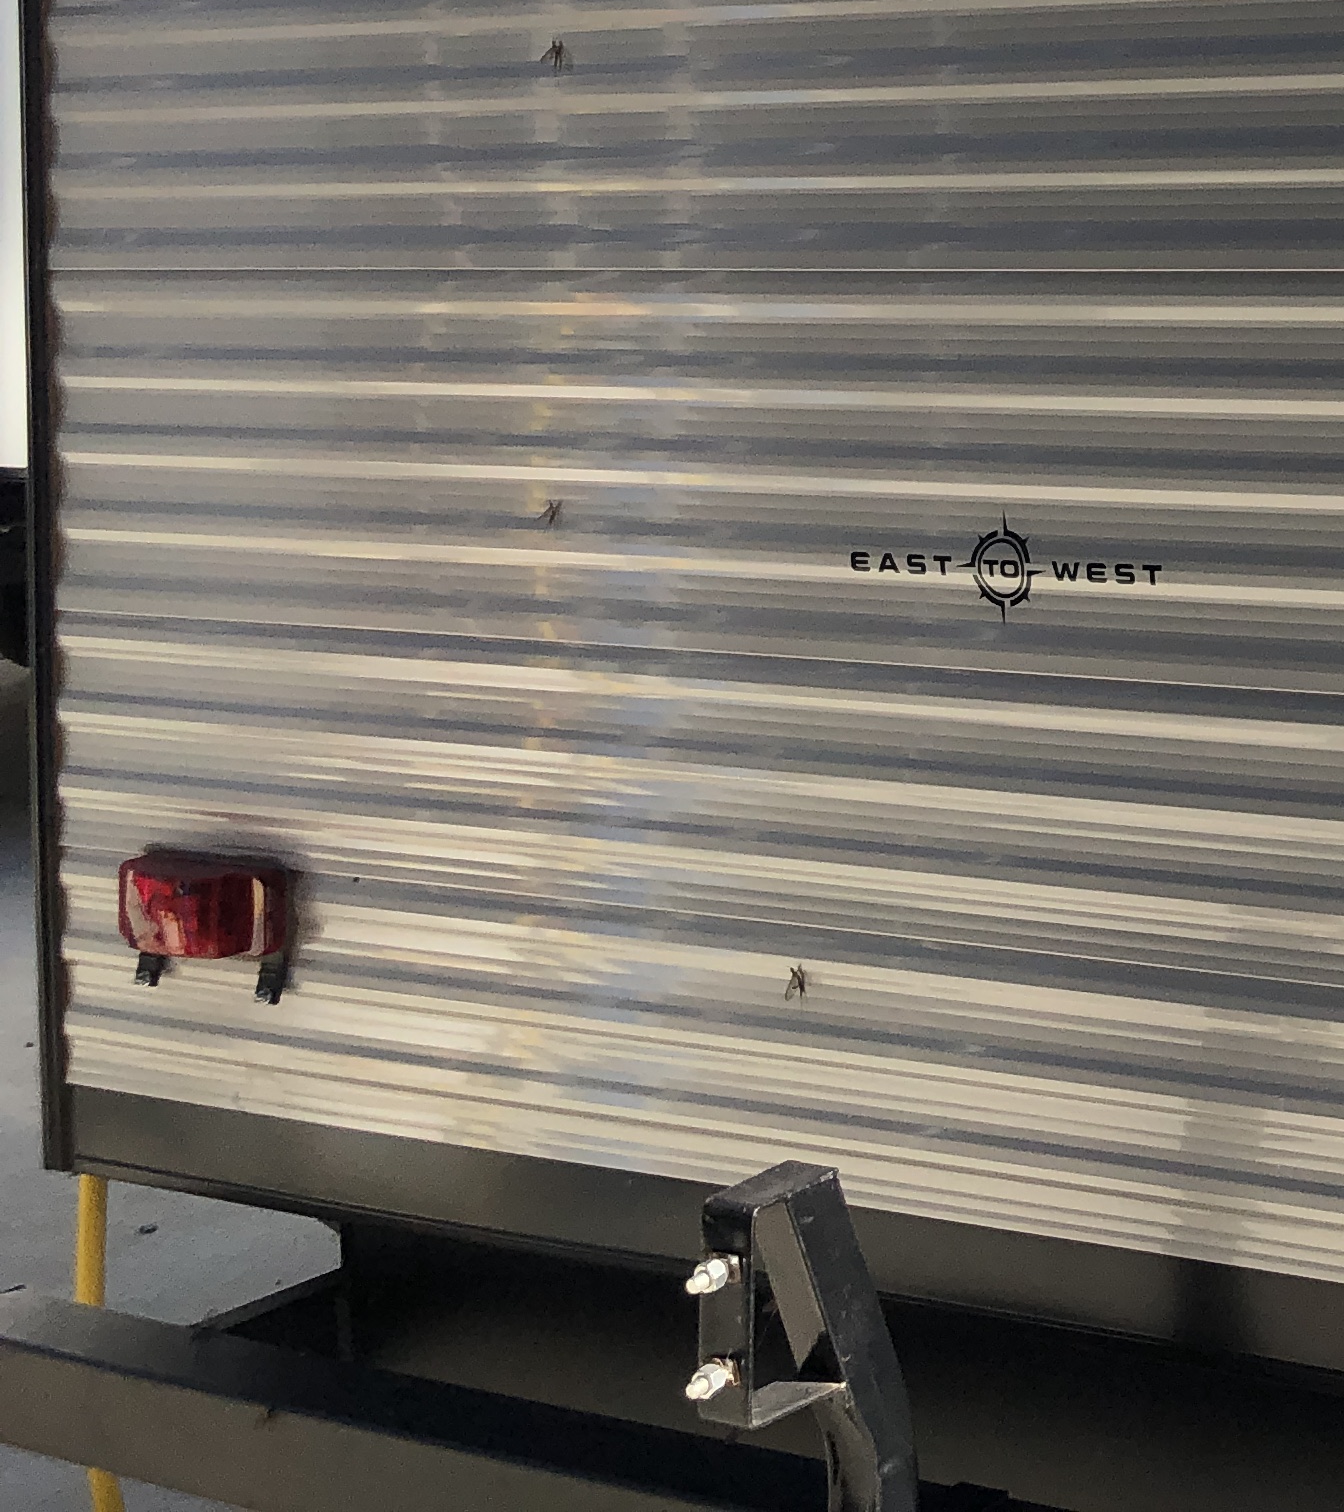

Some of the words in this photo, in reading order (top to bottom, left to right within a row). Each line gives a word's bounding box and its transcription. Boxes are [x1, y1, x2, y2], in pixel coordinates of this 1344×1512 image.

[850, 551, 952, 576] EAST
[982, 559, 1020, 578] TO
[1051, 560, 1163, 586] WEST
